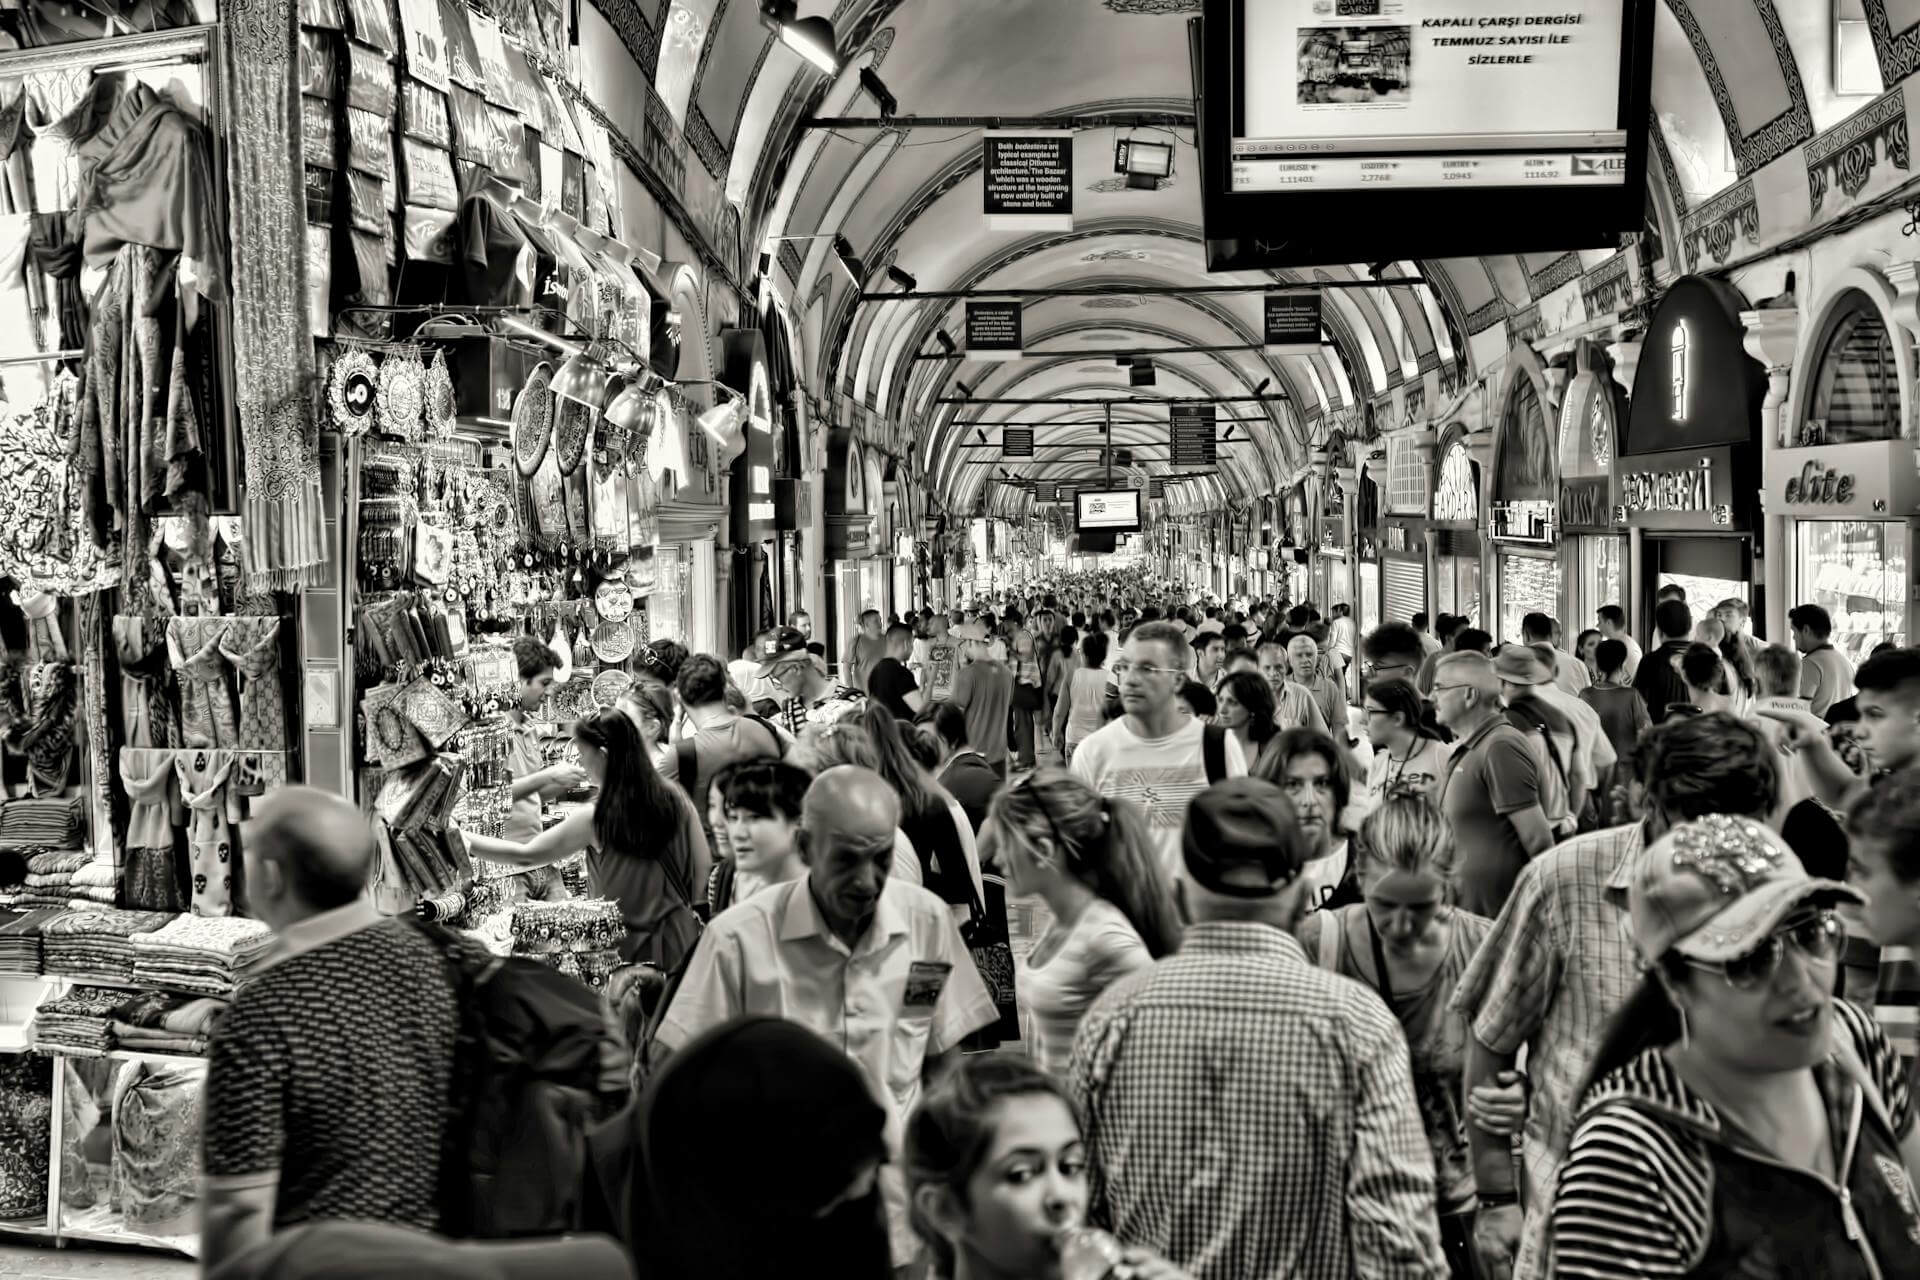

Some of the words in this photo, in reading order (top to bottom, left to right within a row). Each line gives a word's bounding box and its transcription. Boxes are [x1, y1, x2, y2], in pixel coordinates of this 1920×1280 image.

[1421, 18, 1473, 28] KAPALI
[1478, 17, 1520, 29] ÇARŞI
[1524, 13, 1583, 26] DERGİSİ
[1432, 37, 1495, 47] TEMMUZ
[1498, 35, 1544, 46] SAYISI
[1547, 33, 1571, 44] İLE
[1467, 53, 1534, 65] SİZLERLE
[1020, 151, 1051, 159] examples
[1037, 184, 1069, 193] beginning
[993, 192, 1000, 200] is
[1015, 192, 1040, 201] entirely
[1784, 458, 1856, 505] elite
